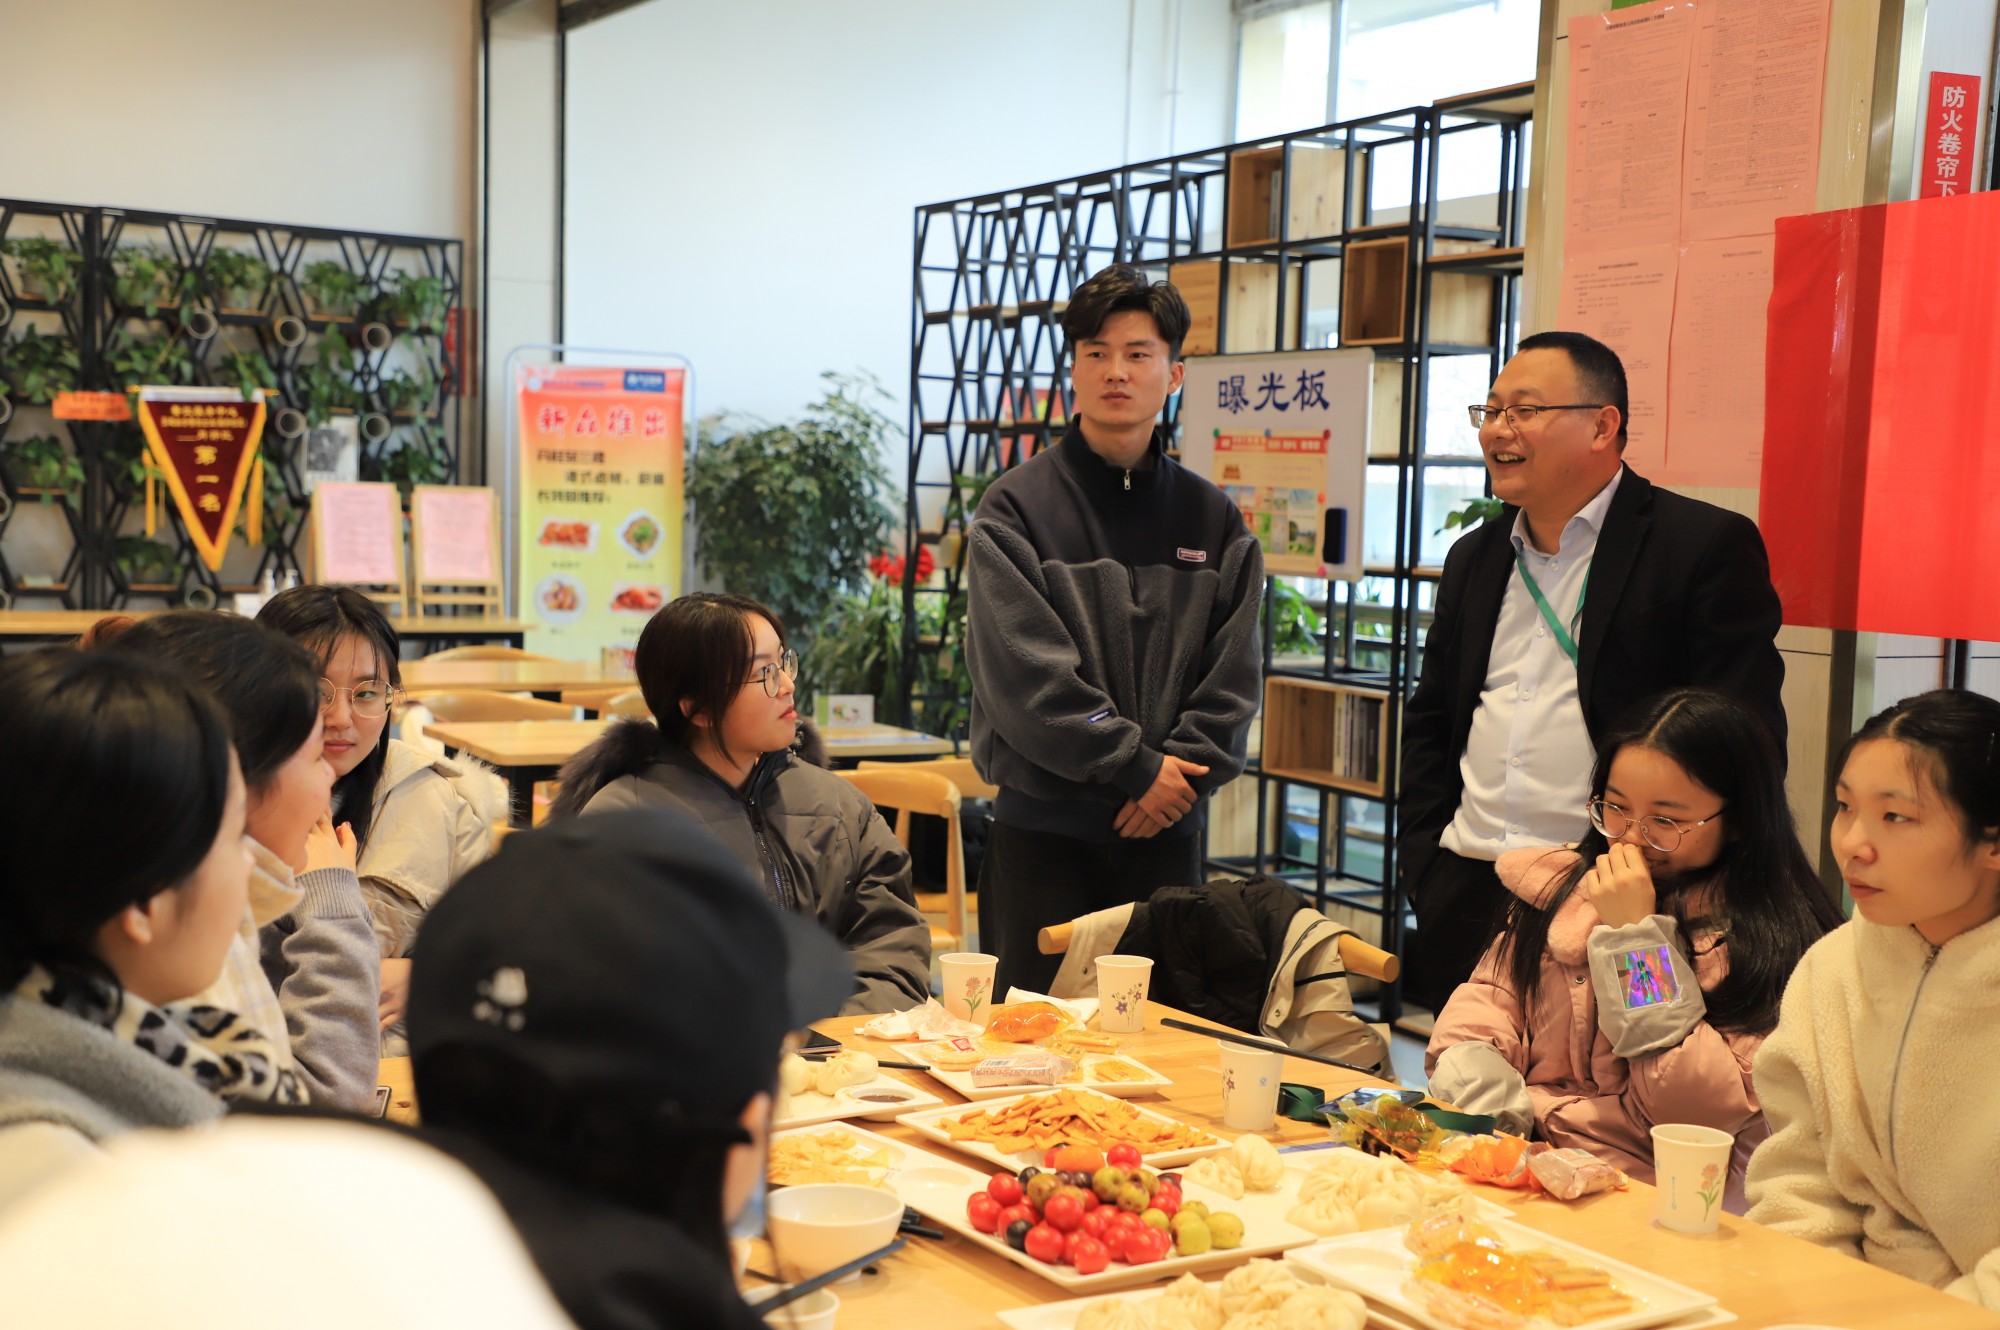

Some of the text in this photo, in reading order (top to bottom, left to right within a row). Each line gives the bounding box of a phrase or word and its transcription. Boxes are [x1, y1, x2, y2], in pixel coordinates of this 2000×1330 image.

[1934, 86, 1967, 198] 防火卷帘下
[1217, 368, 1330, 415] 曝光板
[537, 404, 665, 439] 新品推出
[194, 444, 221, 513] 第一名
